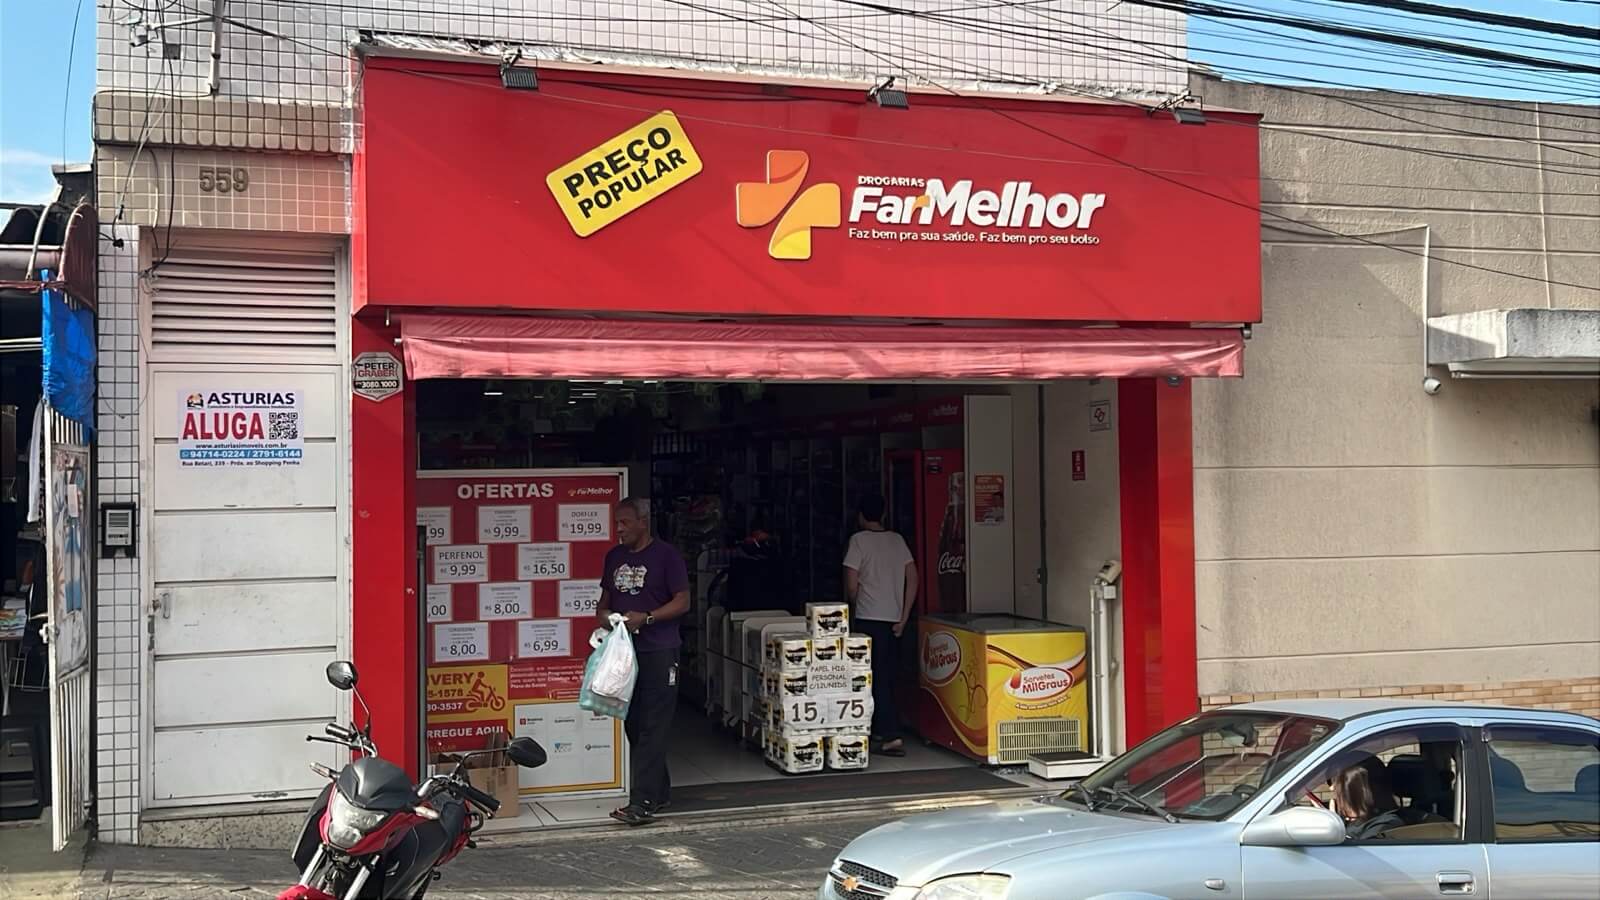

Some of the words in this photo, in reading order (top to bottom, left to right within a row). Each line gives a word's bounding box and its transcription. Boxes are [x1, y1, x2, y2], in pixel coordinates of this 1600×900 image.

[563, 127, 672, 198] PREÇO
[199, 165, 249, 193] 559
[578, 148, 687, 219] POPULAR
[858, 175, 925, 188] DROGARIAS
[848, 178, 1106, 229] FarMelhor
[849, 227, 870, 239] Faz
[872, 228, 897, 240] bem
[899, 231, 919, 242] pra
[920, 231, 940, 241] sua
[942, 231, 979, 242] saúde.
[979, 232, 1000, 243] Faz
[1001, 231, 1026, 243] bem
[1028, 234, 1048, 245] pro
[1049, 234, 1069, 244] seu
[1070, 233, 1100, 245] bolso
[364, 362, 395, 370] PETER
[358, 369, 395, 377] GRABER
[207, 392, 295, 405] ASTURIAS
[182, 412, 265, 440] ALUGA
[190, 449, 246, 458] 94714-0224
[457, 483, 554, 499] OFERTAS
[493, 526, 519, 539] 9,99
[570, 523, 602, 536] 19,99
[439, 550, 484, 560] PERFENOL
[450, 564, 476, 576] 9,99
[533, 563, 565, 576] 16,50
[494, 603, 520, 616] 8,00
[573, 599, 598, 612] 9,99
[450, 643, 476, 657] 8,00
[533, 640, 559, 652] 6,99
[1023, 672, 1055, 684] Sorvetes
[1022, 679, 1068, 694] MilGraus
[475, 725, 504, 737] AQUI
